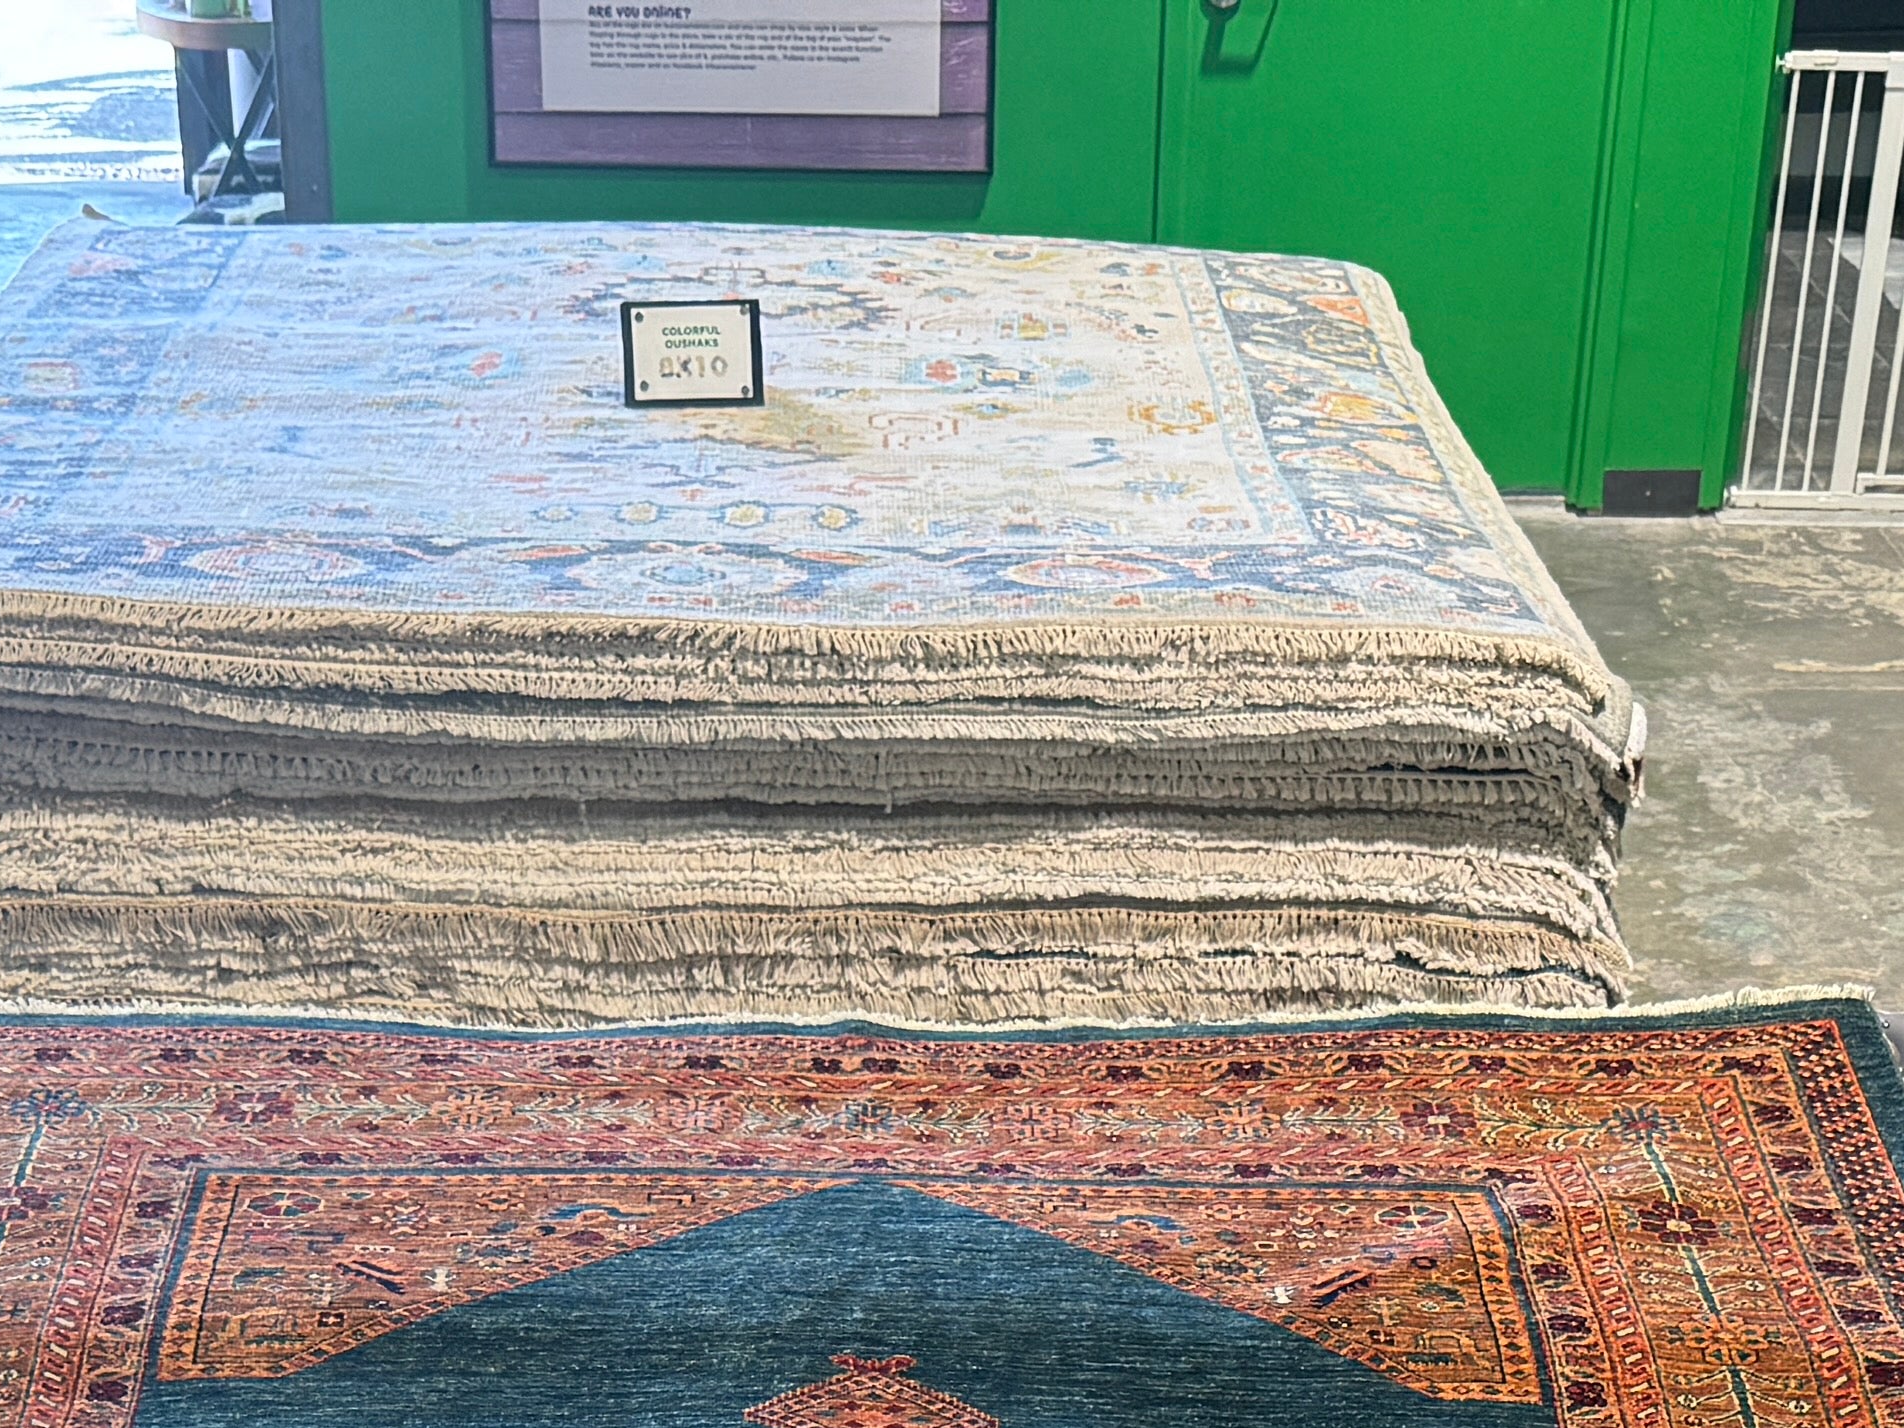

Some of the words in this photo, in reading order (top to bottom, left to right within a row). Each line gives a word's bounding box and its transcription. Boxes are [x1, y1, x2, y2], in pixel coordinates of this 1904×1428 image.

[588, 5, 613, 18] ARE
[616, 6, 640, 18] YOU
[661, 326, 722, 337] COLORFUL
[664, 337, 720, 349] OUSHAKS
